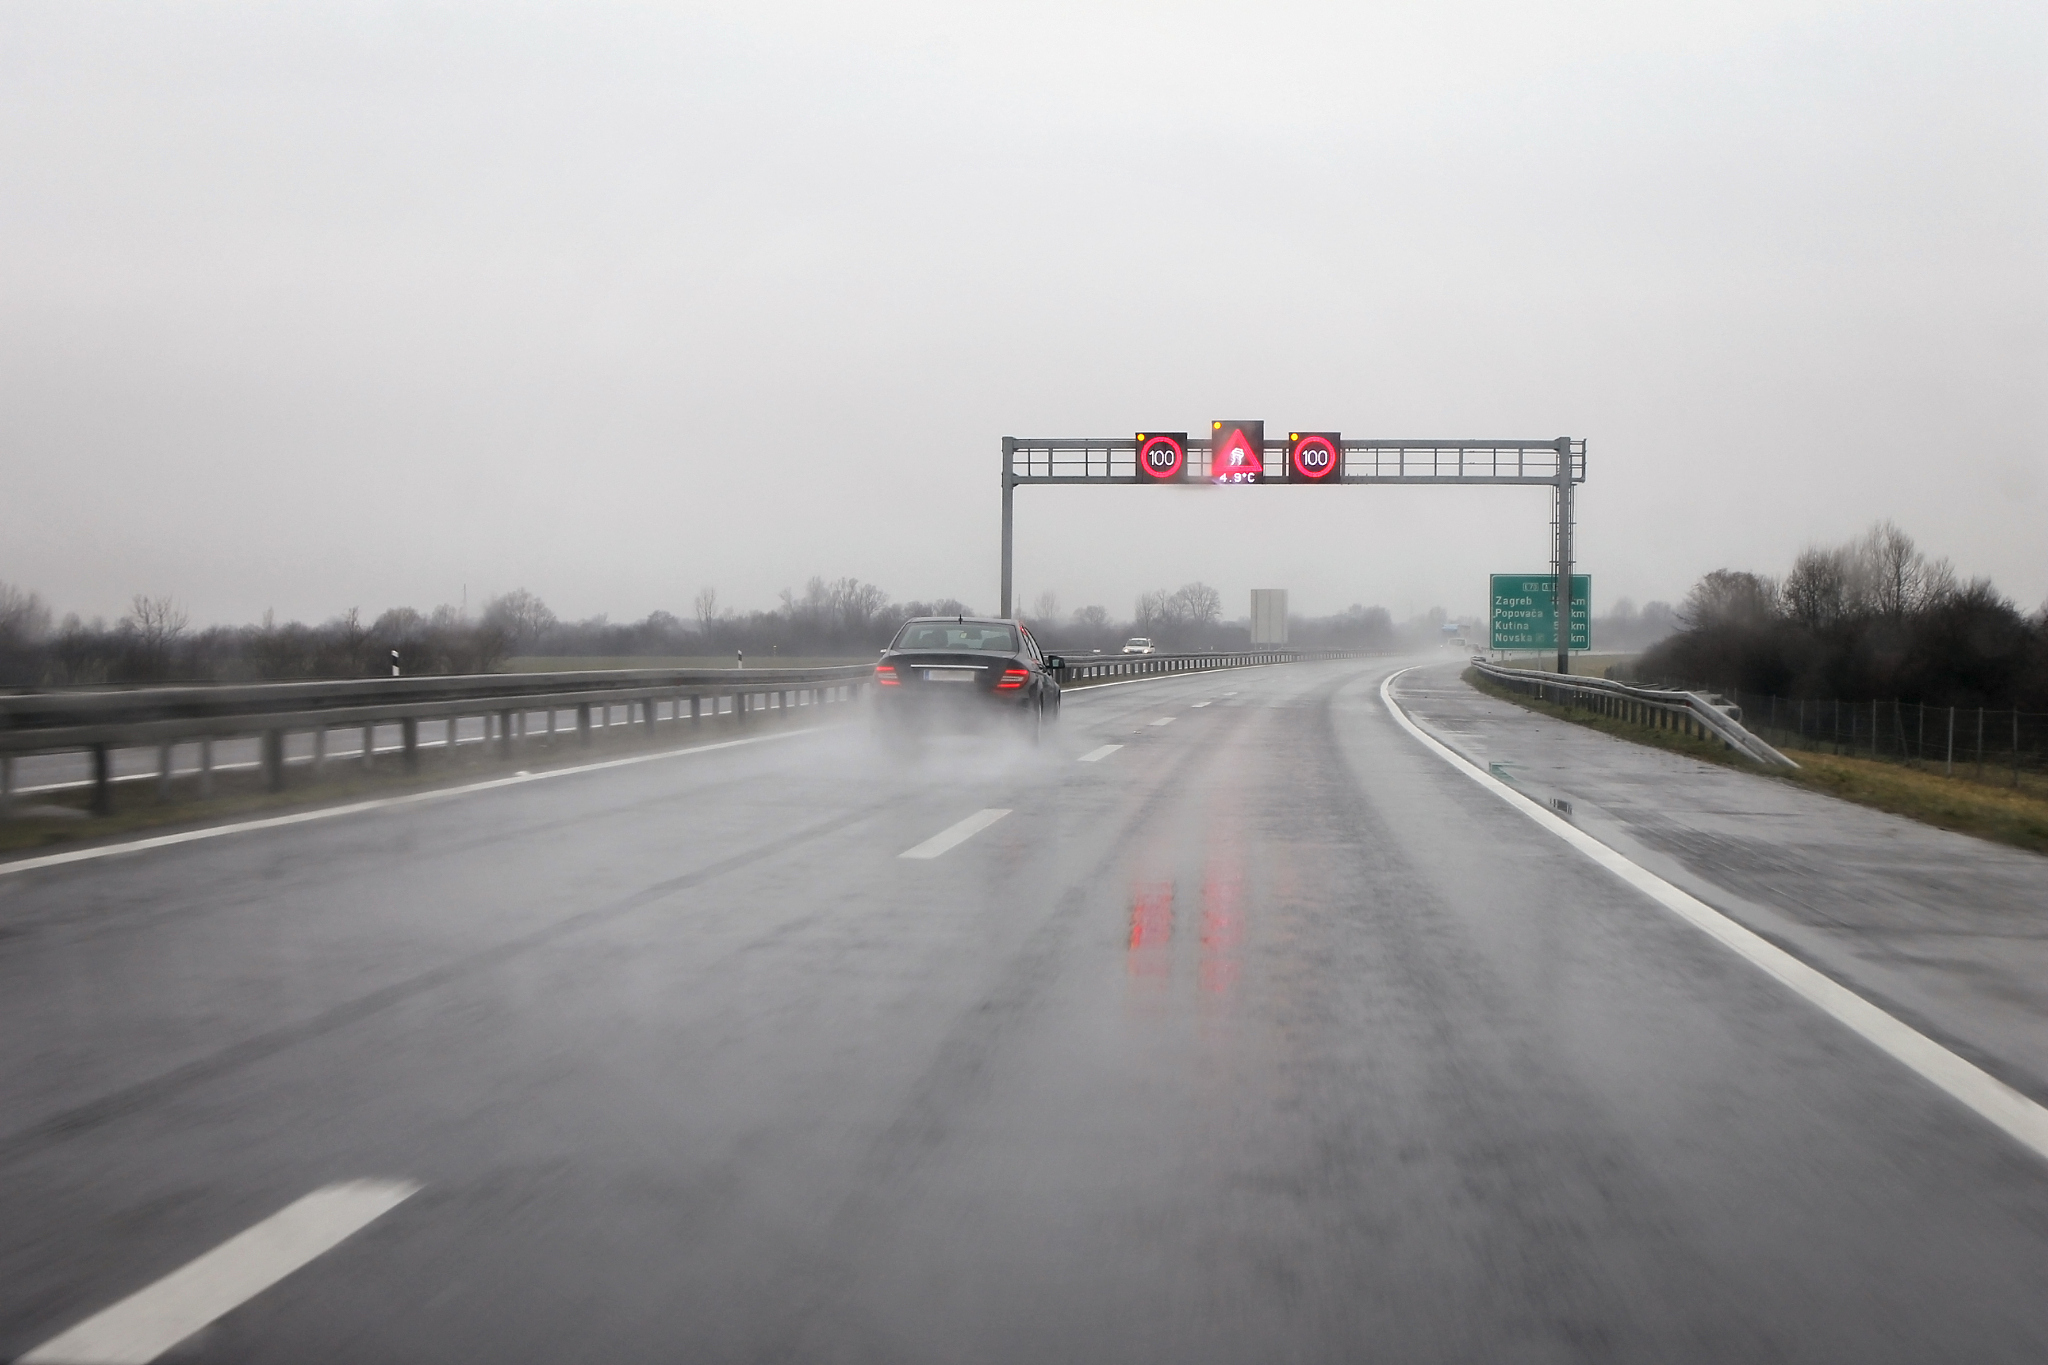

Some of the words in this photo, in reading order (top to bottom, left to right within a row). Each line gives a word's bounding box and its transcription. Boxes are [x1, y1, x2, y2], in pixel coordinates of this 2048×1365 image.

[1148, 450, 1175, 466] 100
[1302, 449, 1328, 466] 100
[1495, 596, 1532, 607] Zagreb
[1495, 609, 1543, 619] Popovača
[1571, 609, 1585, 618] km
[1495, 621, 1529, 630] Kutina
[1571, 622, 1585, 630] km
[1495, 633, 1532, 642] Novska
[1571, 633, 1585, 642] km
